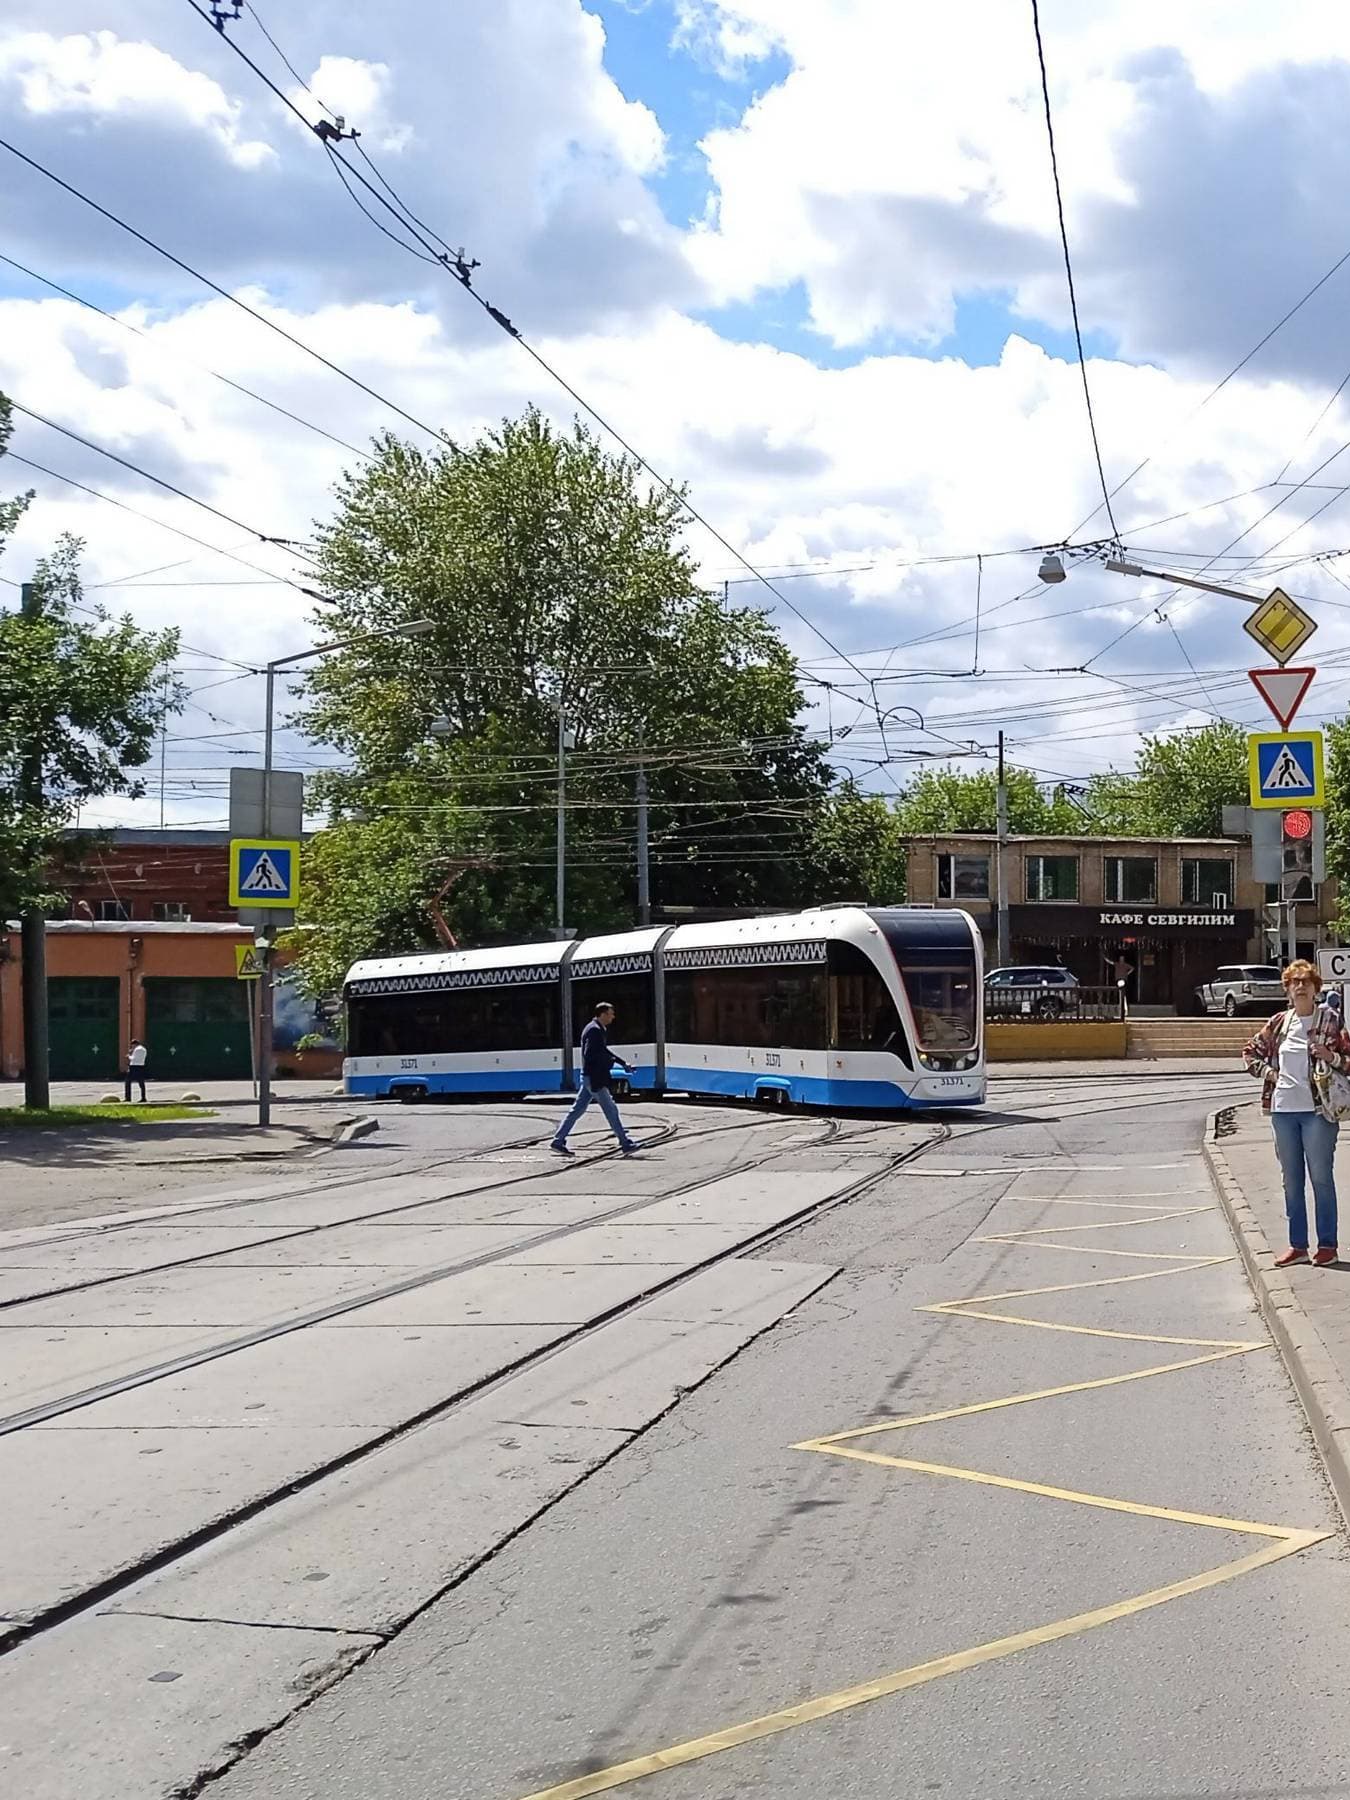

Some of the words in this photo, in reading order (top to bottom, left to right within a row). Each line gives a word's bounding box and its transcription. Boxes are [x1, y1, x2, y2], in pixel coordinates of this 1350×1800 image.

[1100, 913, 1143, 925] КАФЕ
[1147, 914, 1235, 926] СЕВГИЛИМ
[941, 1076, 964, 1086] 31371
